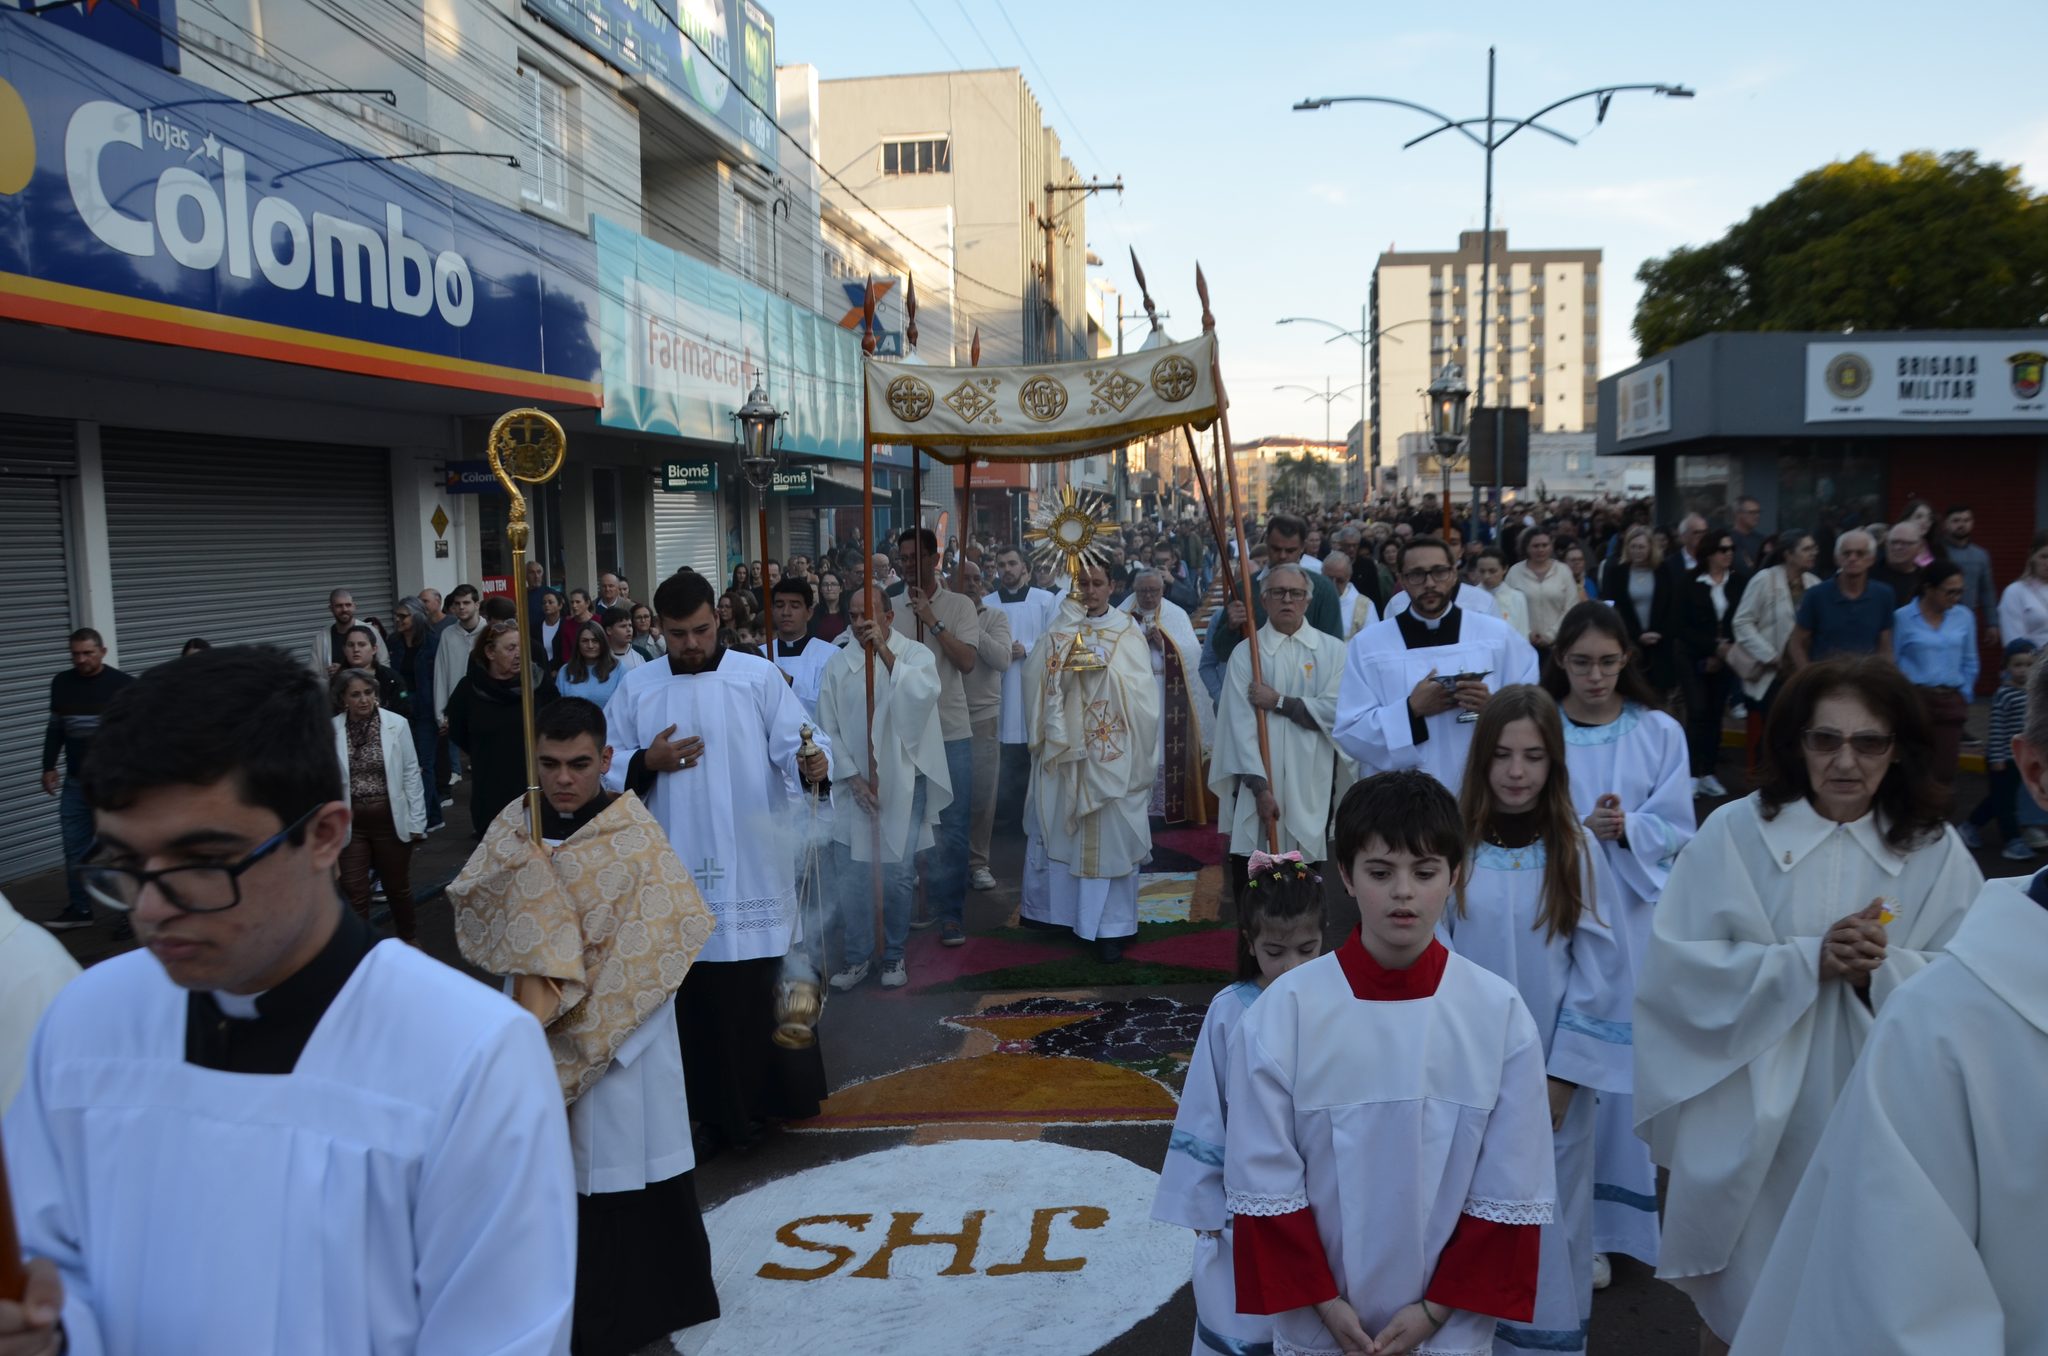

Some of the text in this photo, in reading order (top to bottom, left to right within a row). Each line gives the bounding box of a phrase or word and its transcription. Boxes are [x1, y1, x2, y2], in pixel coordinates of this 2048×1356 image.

[145, 108, 191, 151] lojas
[65, 100, 475, 328] Colombo
[648, 315, 740, 388] Farmácia
[1897, 354, 1978, 377] BRIGADA
[1897, 379, 1977, 401] MILITAR
[461, 470, 496, 483] Colom
